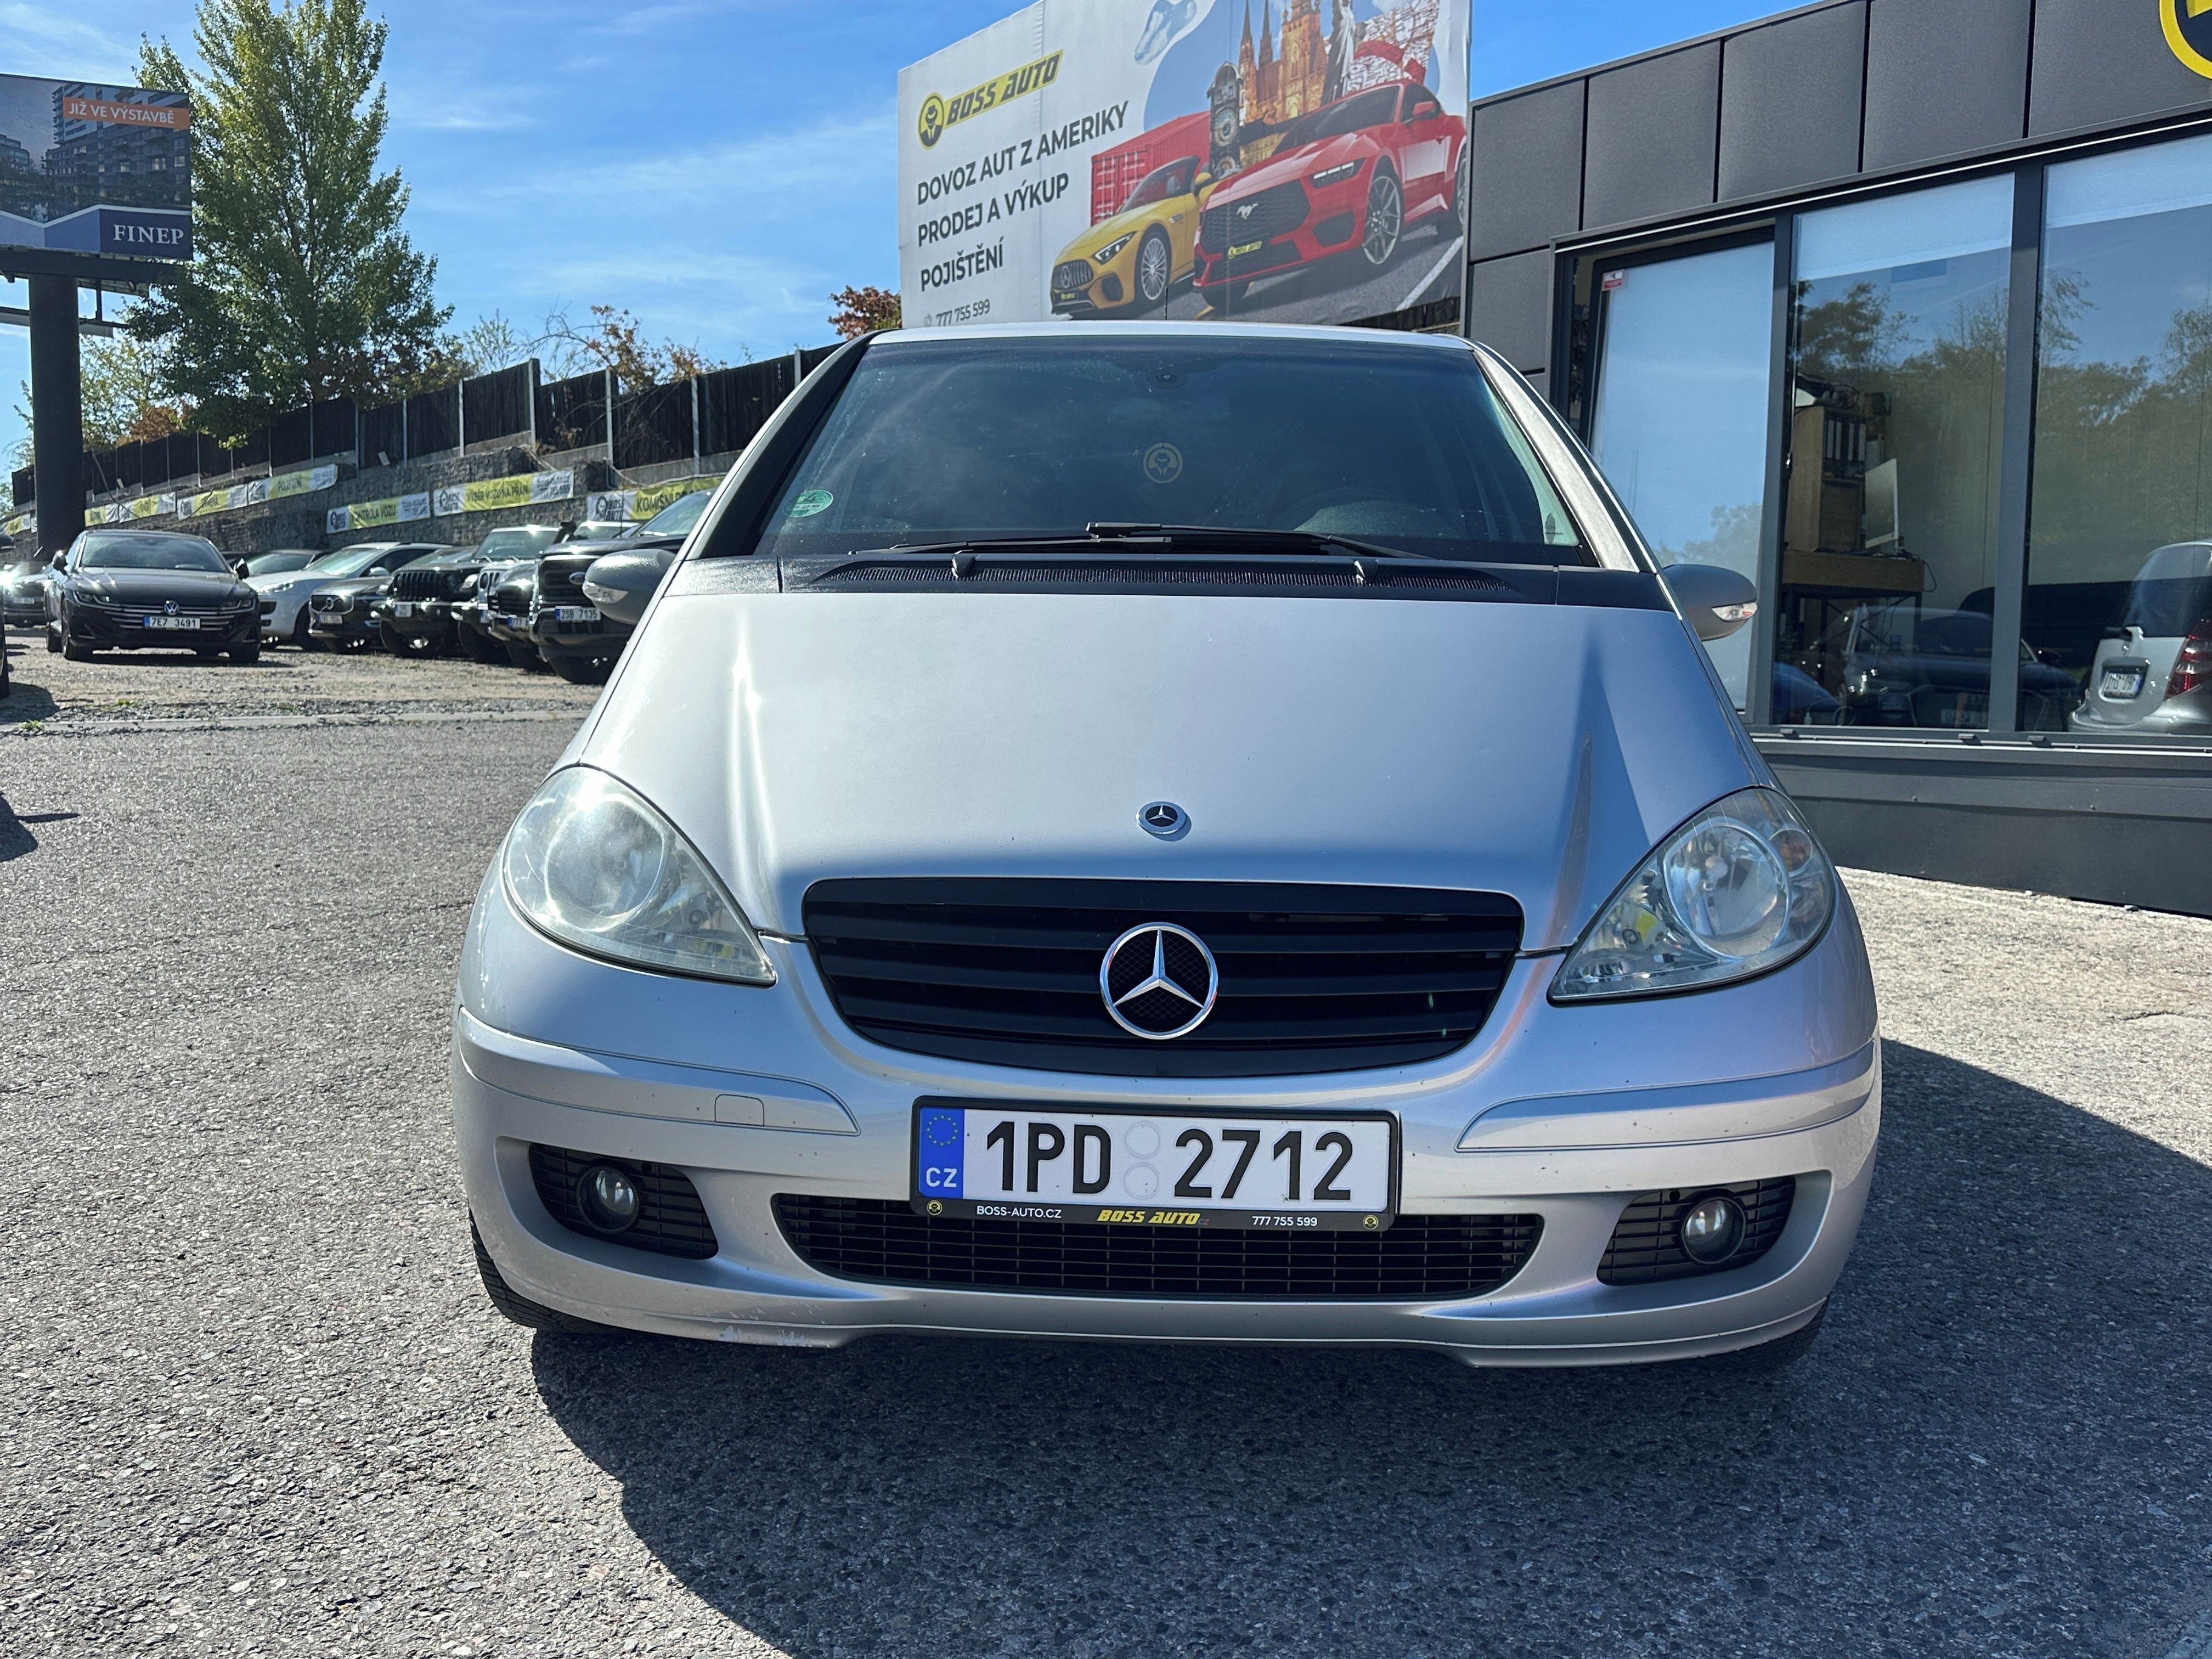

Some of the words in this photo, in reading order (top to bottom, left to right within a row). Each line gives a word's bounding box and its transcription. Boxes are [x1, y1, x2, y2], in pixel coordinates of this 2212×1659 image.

[946, 81, 997, 126] BOSS
[1000, 54, 1060, 103] AUTO
[69, 101, 88, 116] JIŽ
[90, 105, 108, 118] VE
[111, 106, 175, 124] VÝSTAVBĚ
[917, 161, 977, 206] DOVOZ
[980, 145, 1017, 182] AUT
[1020, 139, 1033, 166] Z
[1036, 100, 1130, 161] AMERIKY
[918, 202, 983, 247] PRODEJ
[987, 197, 1001, 224] A
[1004, 172, 1069, 216] VÝKUP
[113, 224, 184, 245] FINEP
[921, 236, 1005, 292] POJIŠTĚNÍ
[936, 310, 952, 326] 777
[955, 304, 970, 321] 755
[973, 299, 990, 317] 599
[152, 618, 167, 627] 7E7
[175, 618, 195, 627] 3491
[579, 609, 597, 619] 7135
[986, 1120, 1112, 1195] 1PD
[1173, 1128, 1353, 1201] 2712
[926, 1166, 958, 1188] CZ
[976, 1205, 1062, 1219] BOSS-AUTO.CZ
[1097, 1209, 1146, 1223] BOSS
[1148, 1211, 1200, 1225] AUTO
[1251, 1216, 1272, 1226] 777
[1273, 1216, 1294, 1226] 755
[1296, 1216, 1318, 1227] 599
